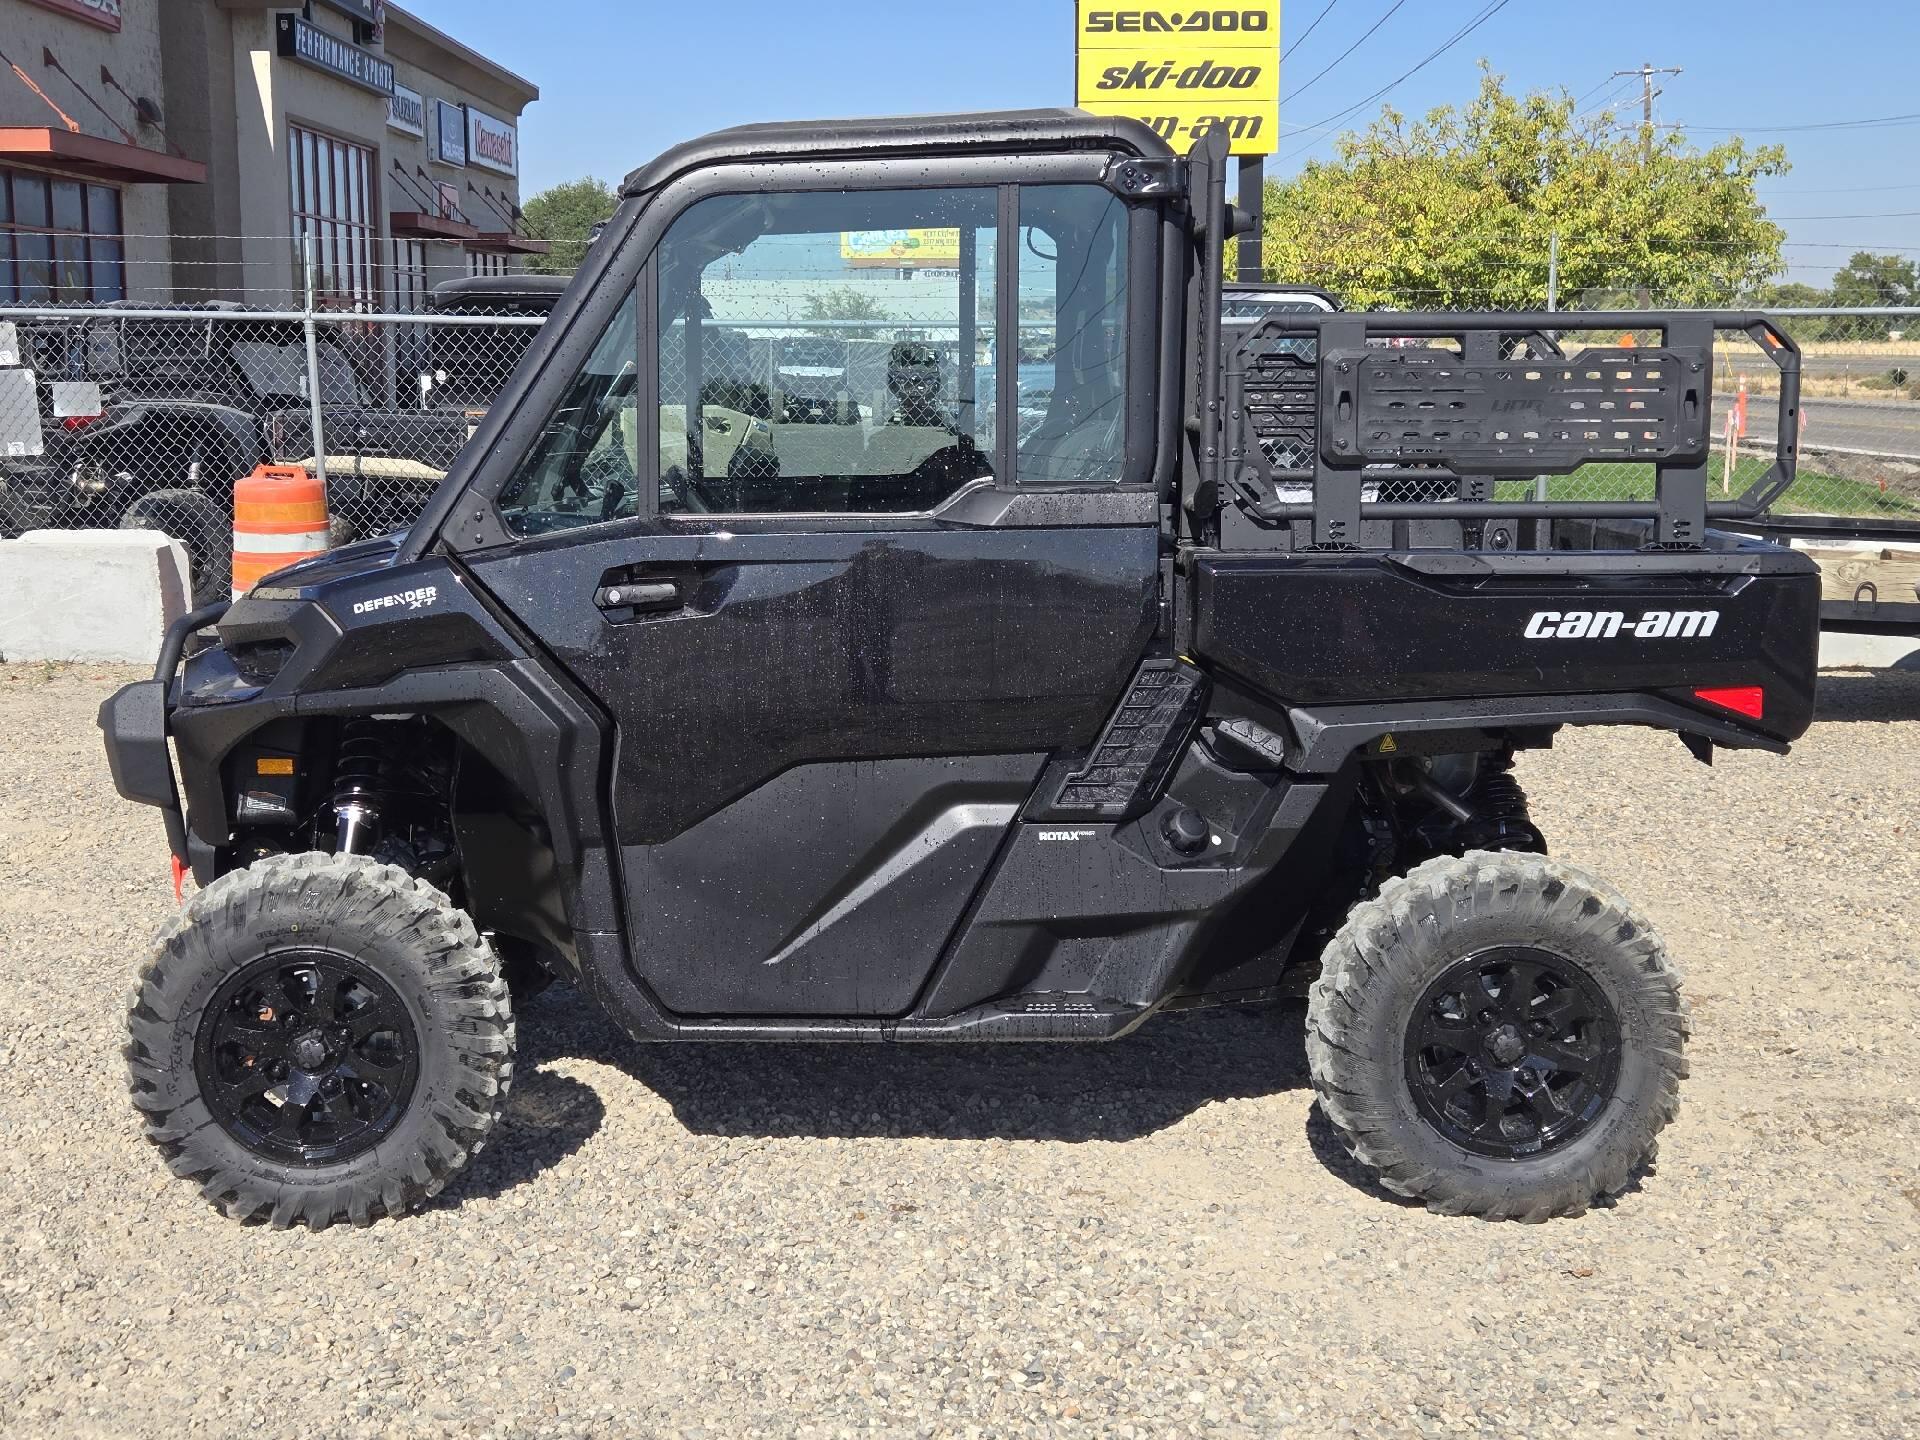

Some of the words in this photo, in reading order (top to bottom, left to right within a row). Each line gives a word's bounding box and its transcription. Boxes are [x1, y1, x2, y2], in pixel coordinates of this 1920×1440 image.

[296, 23, 361, 77] PERFORMANCE
[364, 56, 393, 91] SPORTS
[1096, 60, 1262, 90] ski-doo
[392, 95, 423, 129] SUZUKI
[474, 118, 513, 168] Kawasaki
[353, 586, 437, 614] DEFENDER
[409, 597, 437, 610] XT
[1523, 611, 1720, 639] can-am
[1039, 831, 1079, 841] ROTAX
